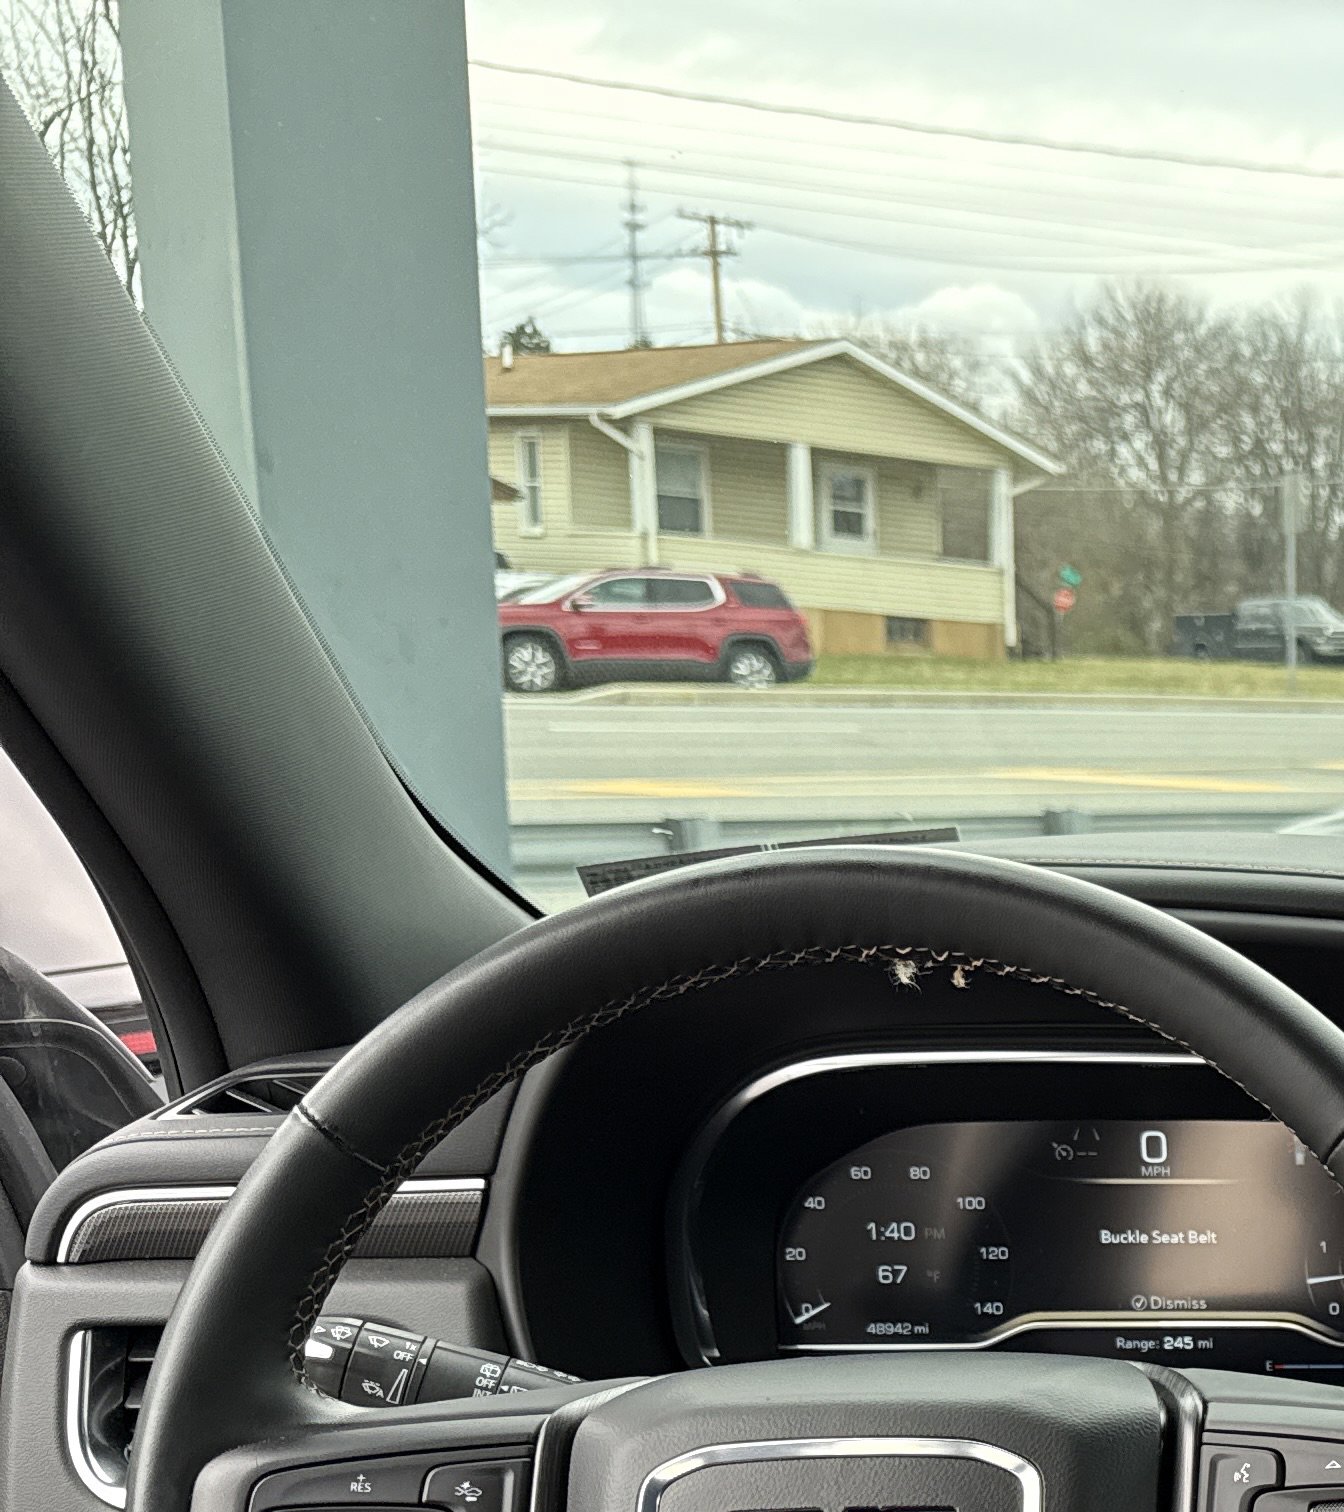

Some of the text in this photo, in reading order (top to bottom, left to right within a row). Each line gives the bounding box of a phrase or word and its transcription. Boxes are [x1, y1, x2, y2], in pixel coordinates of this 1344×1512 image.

[1140, 1130, 1168, 1163] 0
[849, 1166, 871, 1180] 60
[909, 1166, 930, 1180] 80
[1141, 1166, 1170, 1177] MPH
[804, 1196, 825, 1210] 40
[956, 1196, 986, 1210] 100
[866, 1221, 946, 1241] 1:40 PM
[1099, 1229, 1217, 1244] Buckle Seat Belt
[785, 1247, 806, 1261] 20
[979, 1246, 1009, 1260] 120
[1318, 1241, 1328, 1253] 1
[877, 1265, 908, 1284] 67
[974, 1302, 1005, 1315] 140
[1149, 1296, 1207, 1310] Dismiss
[1328, 1302, 1340, 1315] 0
[866, 1323, 929, 1335] 48942 mi
[1116, 1336, 1213, 1352] Range: 245 mi
[393, 1350, 414, 1362] OFF
[1265, 1360, 1274, 1371] E
[475, 1376, 497, 1388] OFF
[472, 1388, 493, 1398] INT
[350, 1480, 372, 1493] RES
